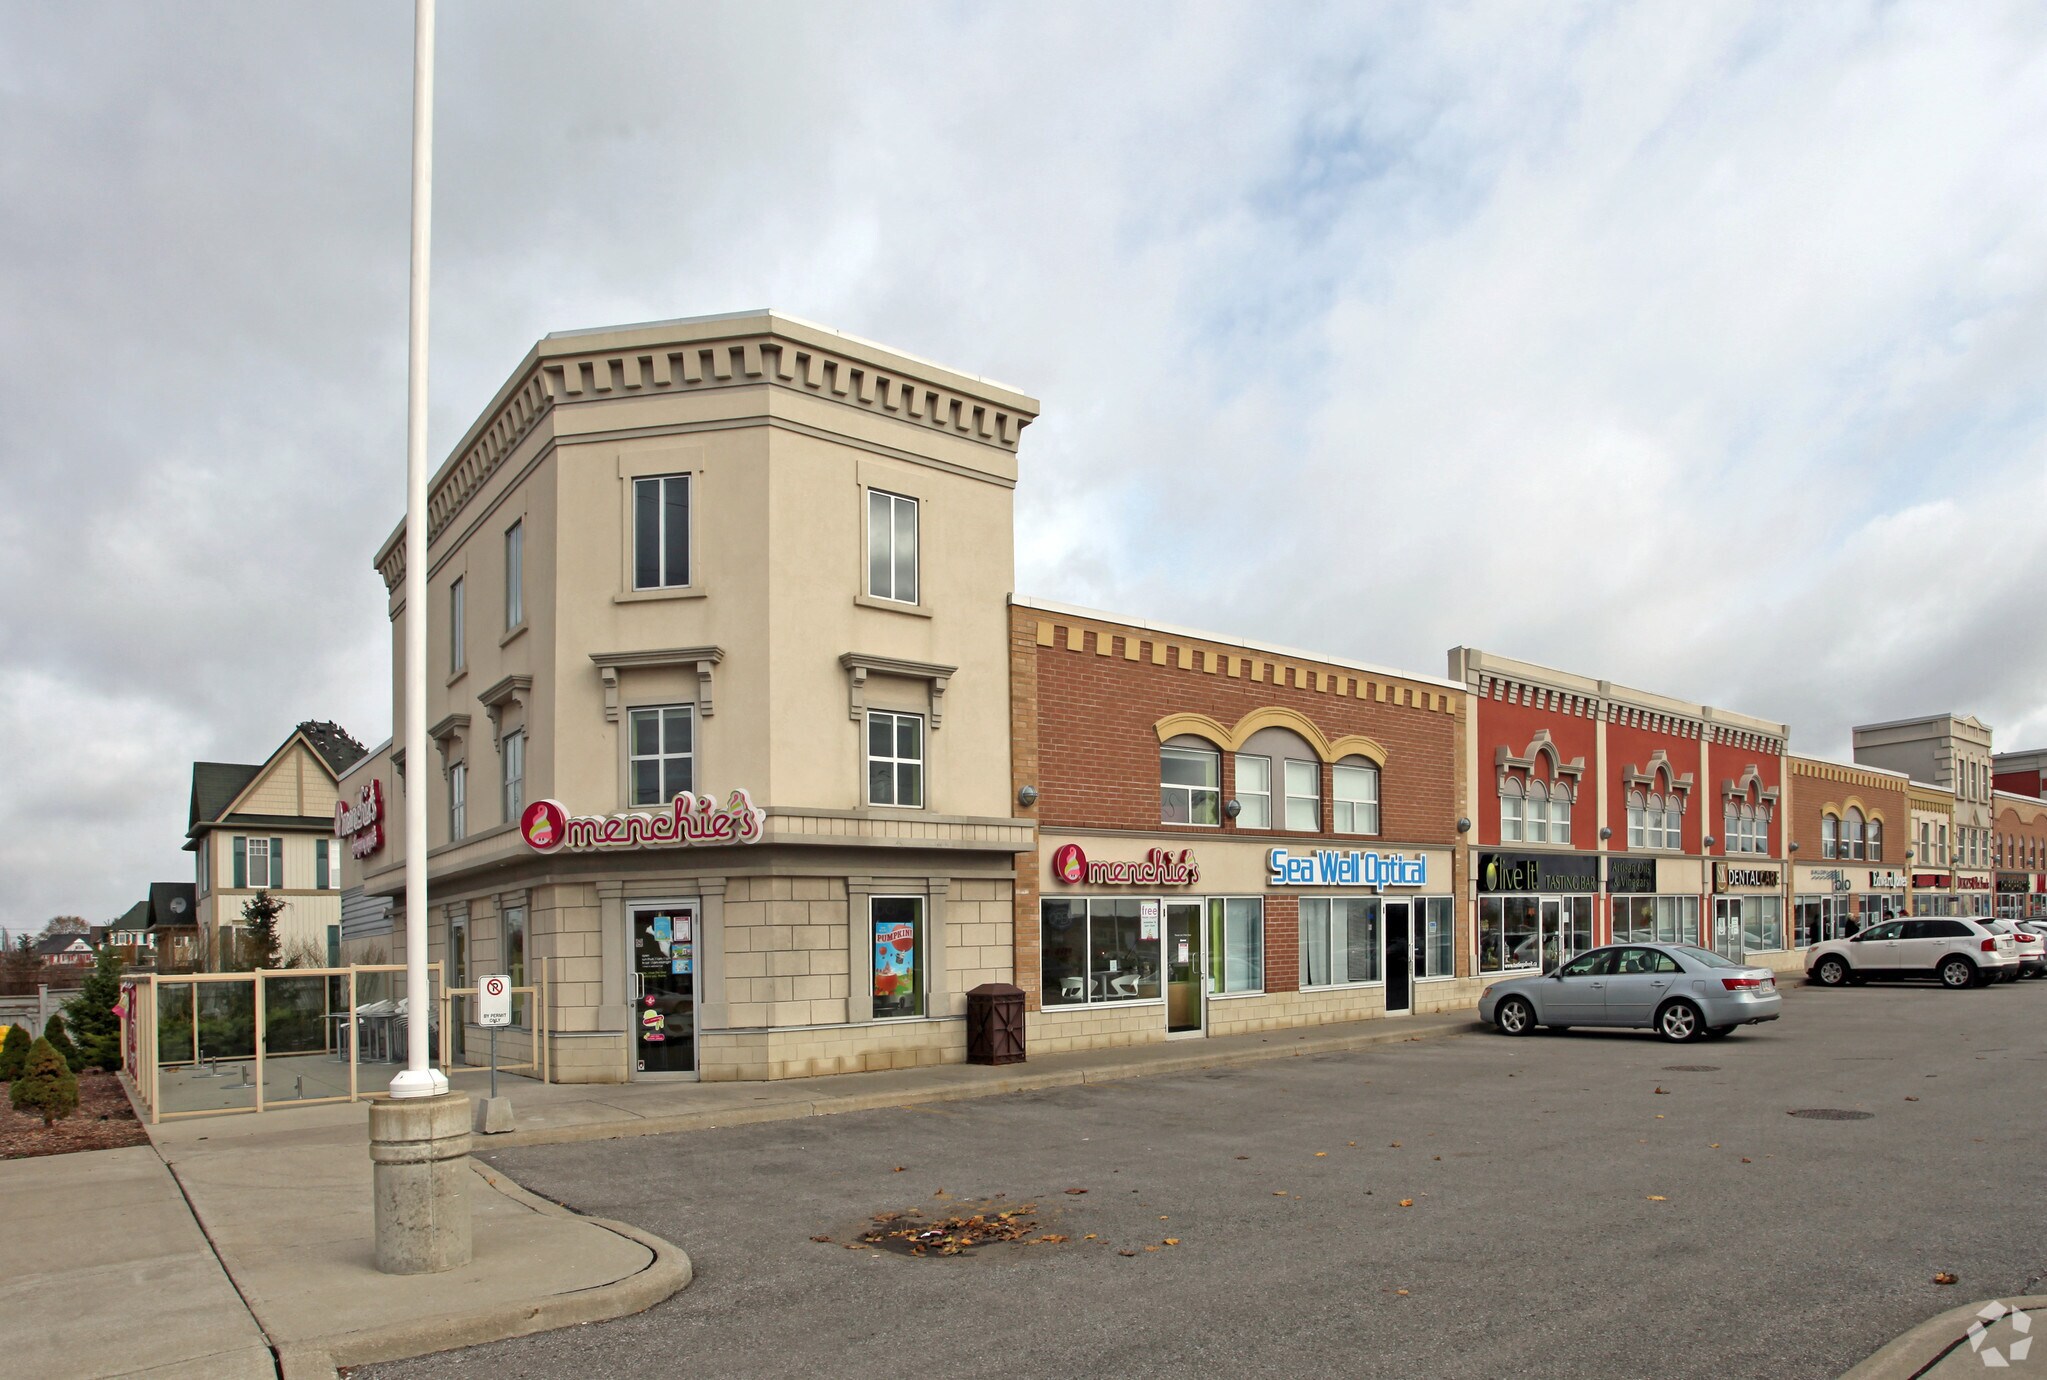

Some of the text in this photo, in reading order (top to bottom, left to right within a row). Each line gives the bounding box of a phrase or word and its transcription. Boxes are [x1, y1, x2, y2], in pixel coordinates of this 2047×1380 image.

[566, 791, 757, 847] menchie's
[1087, 846, 1200, 885] menchie's
[1271, 849, 1426, 892] Sea Well Optical
[1612, 861, 1636, 874] Artisan
[1546, 874, 1596, 890] TASTING BAR
[1620, 876, 1650, 889] Vinegars
[1141, 905, 1158, 916] free
